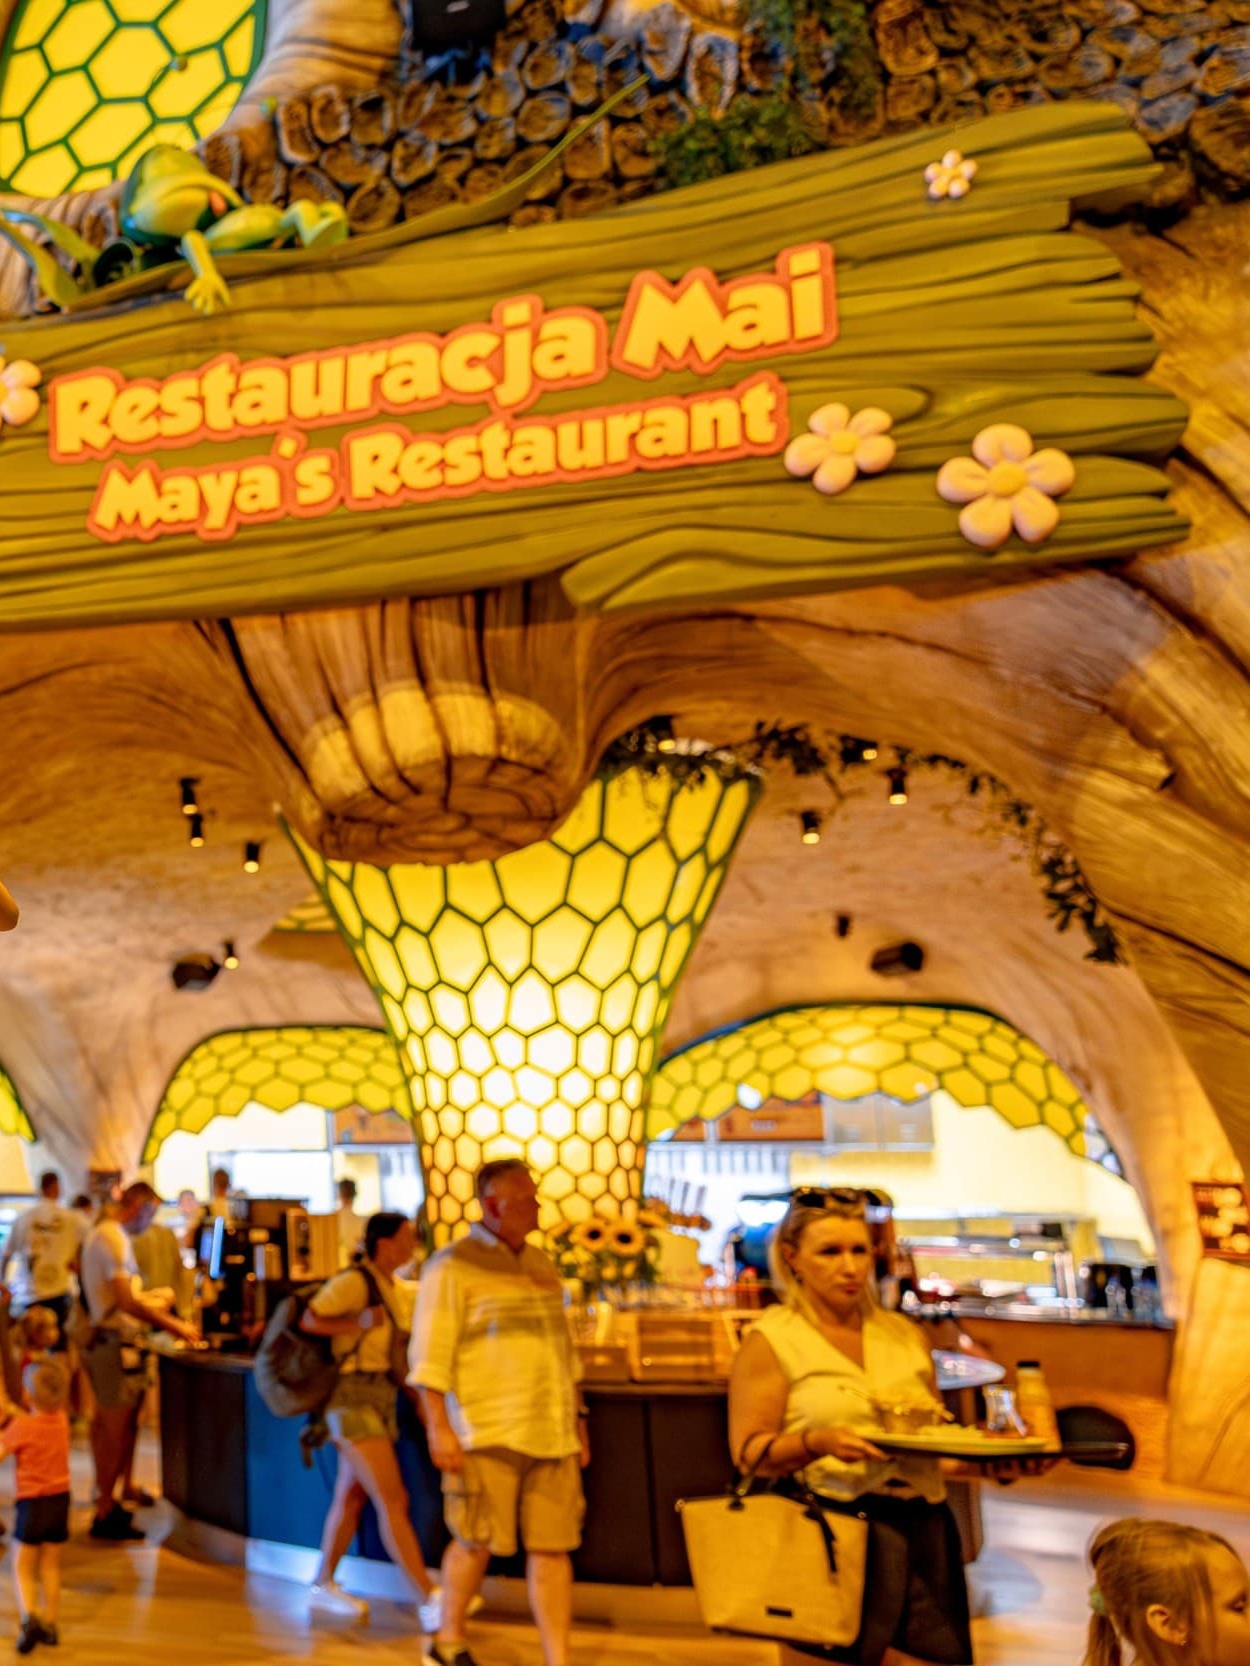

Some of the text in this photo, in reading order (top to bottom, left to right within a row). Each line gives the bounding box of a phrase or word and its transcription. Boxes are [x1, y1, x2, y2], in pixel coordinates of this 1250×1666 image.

[53, 250, 825, 454] Restauracja Mai
[93, 381, 778, 531] Maya's Restaurant
